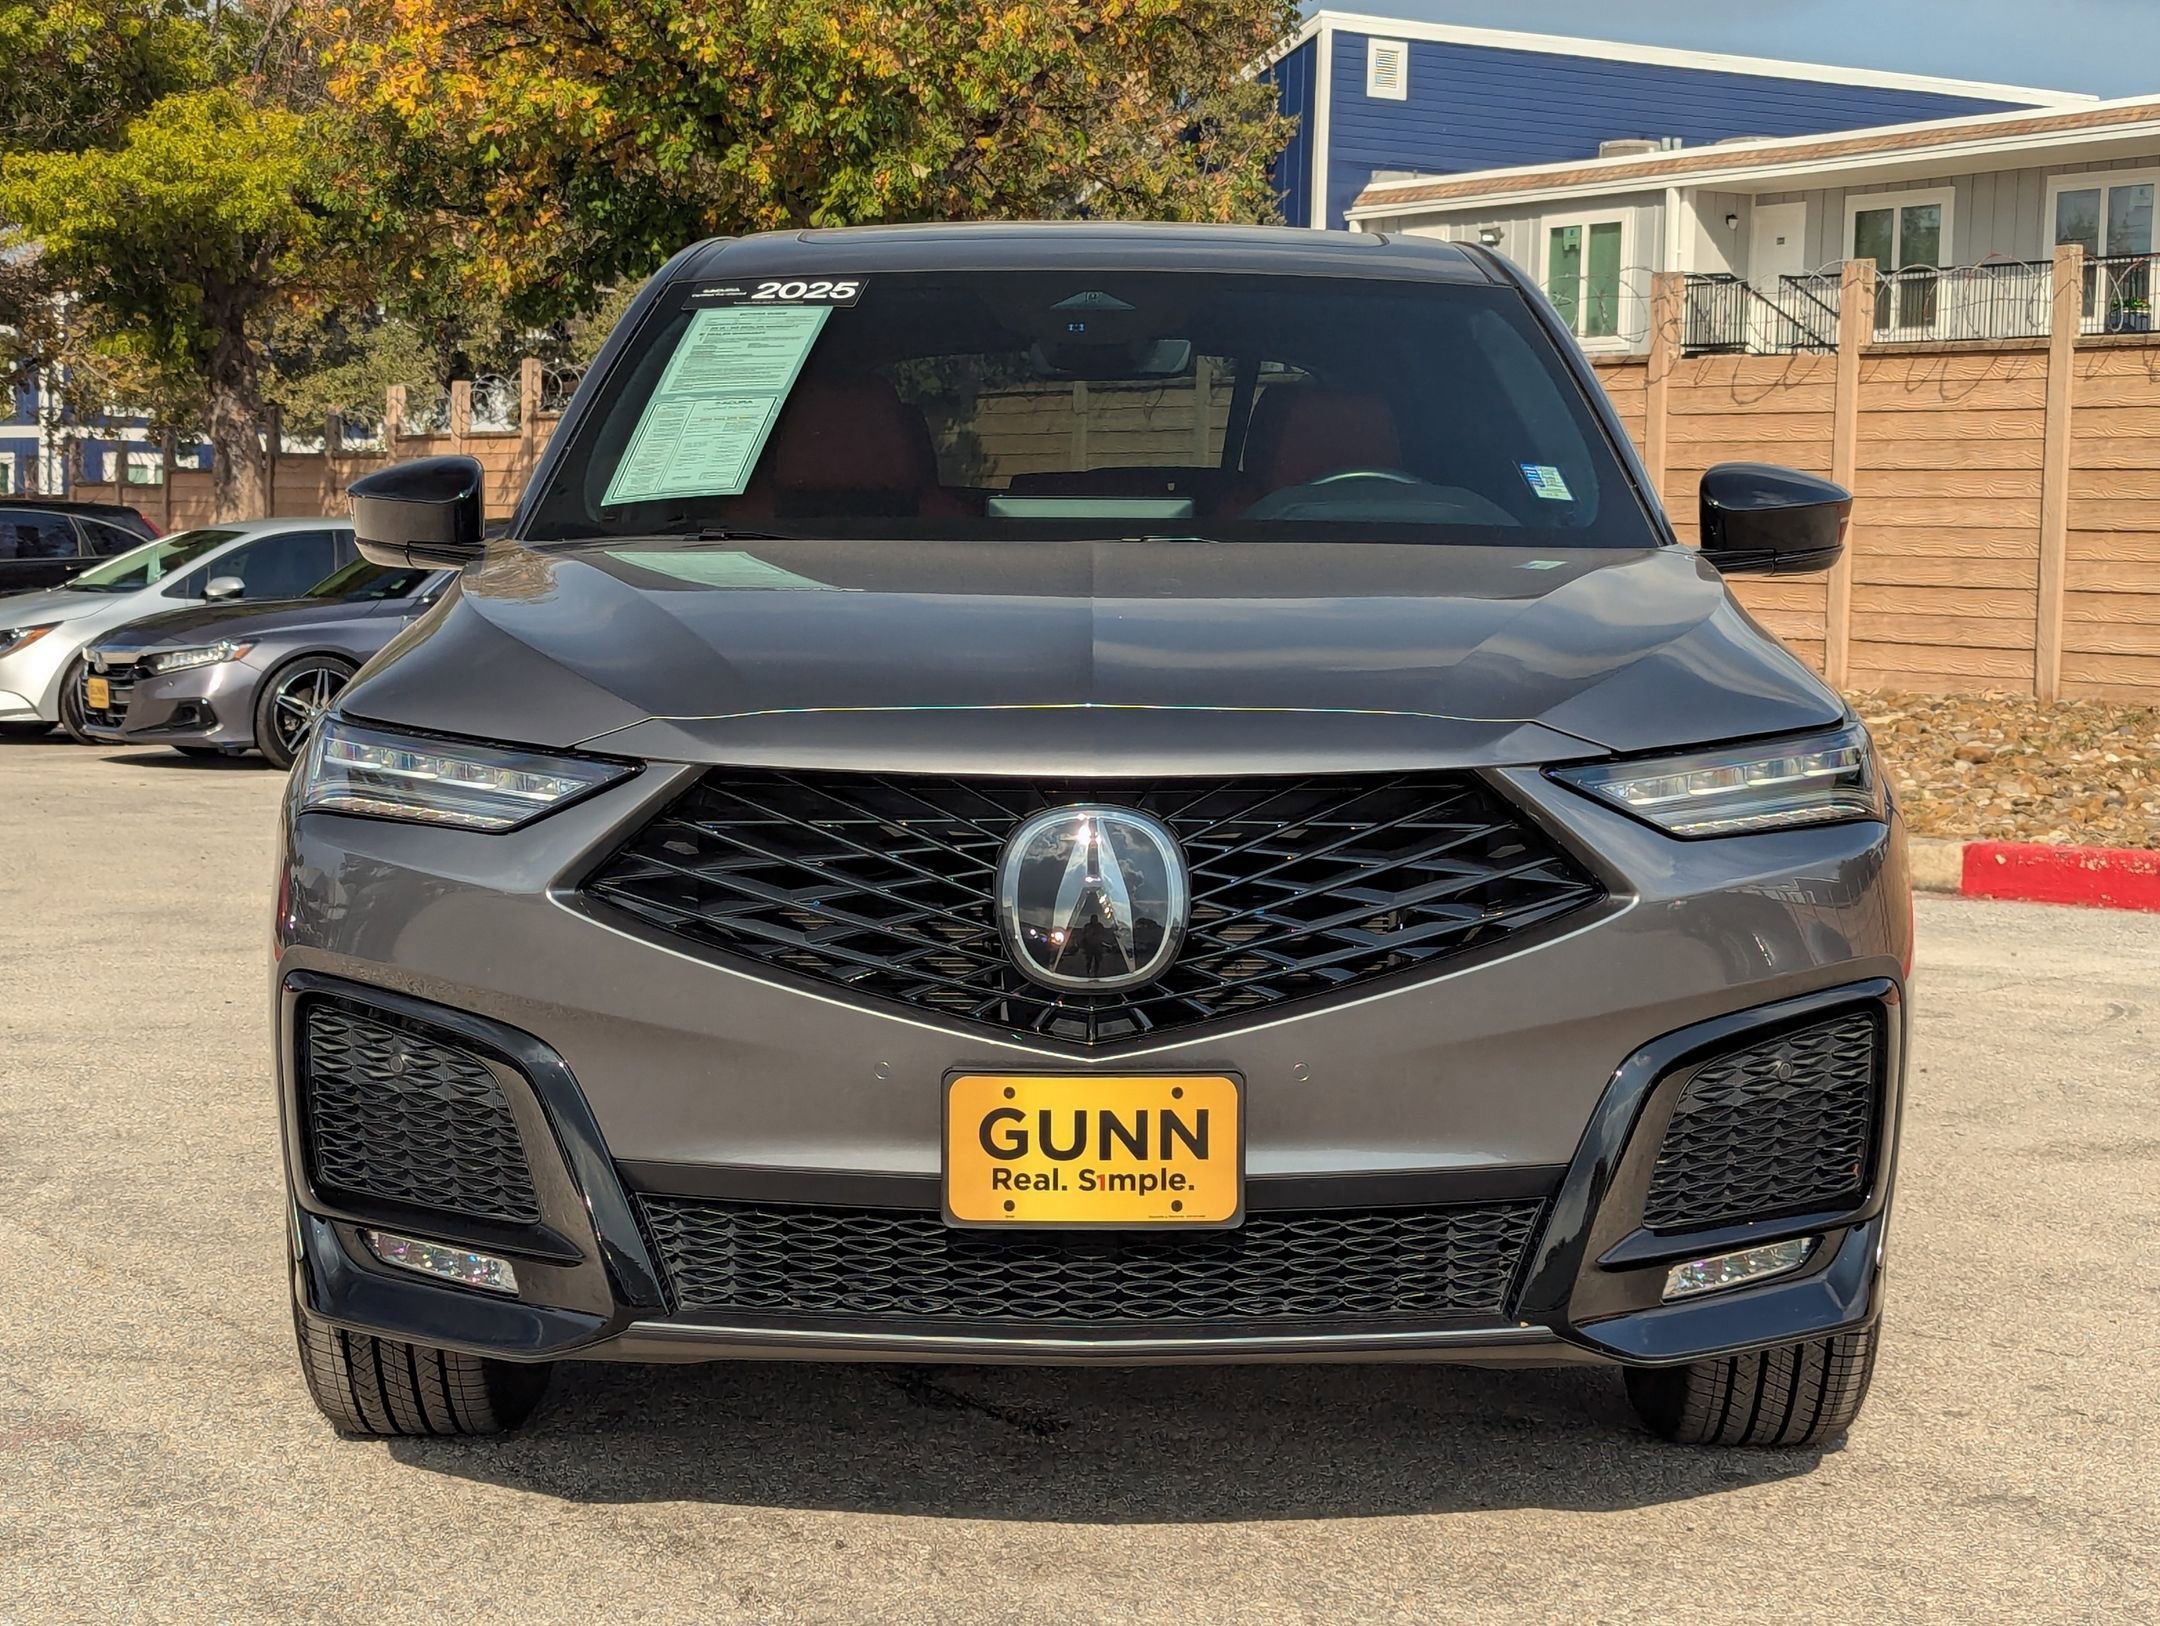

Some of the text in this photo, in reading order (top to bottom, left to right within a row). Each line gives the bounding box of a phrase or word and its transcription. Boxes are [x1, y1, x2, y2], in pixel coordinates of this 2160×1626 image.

[751, 281, 859, 300] 2025
[979, 1107, 1209, 1161] GUNN
[992, 1167, 1068, 1191] Real.
